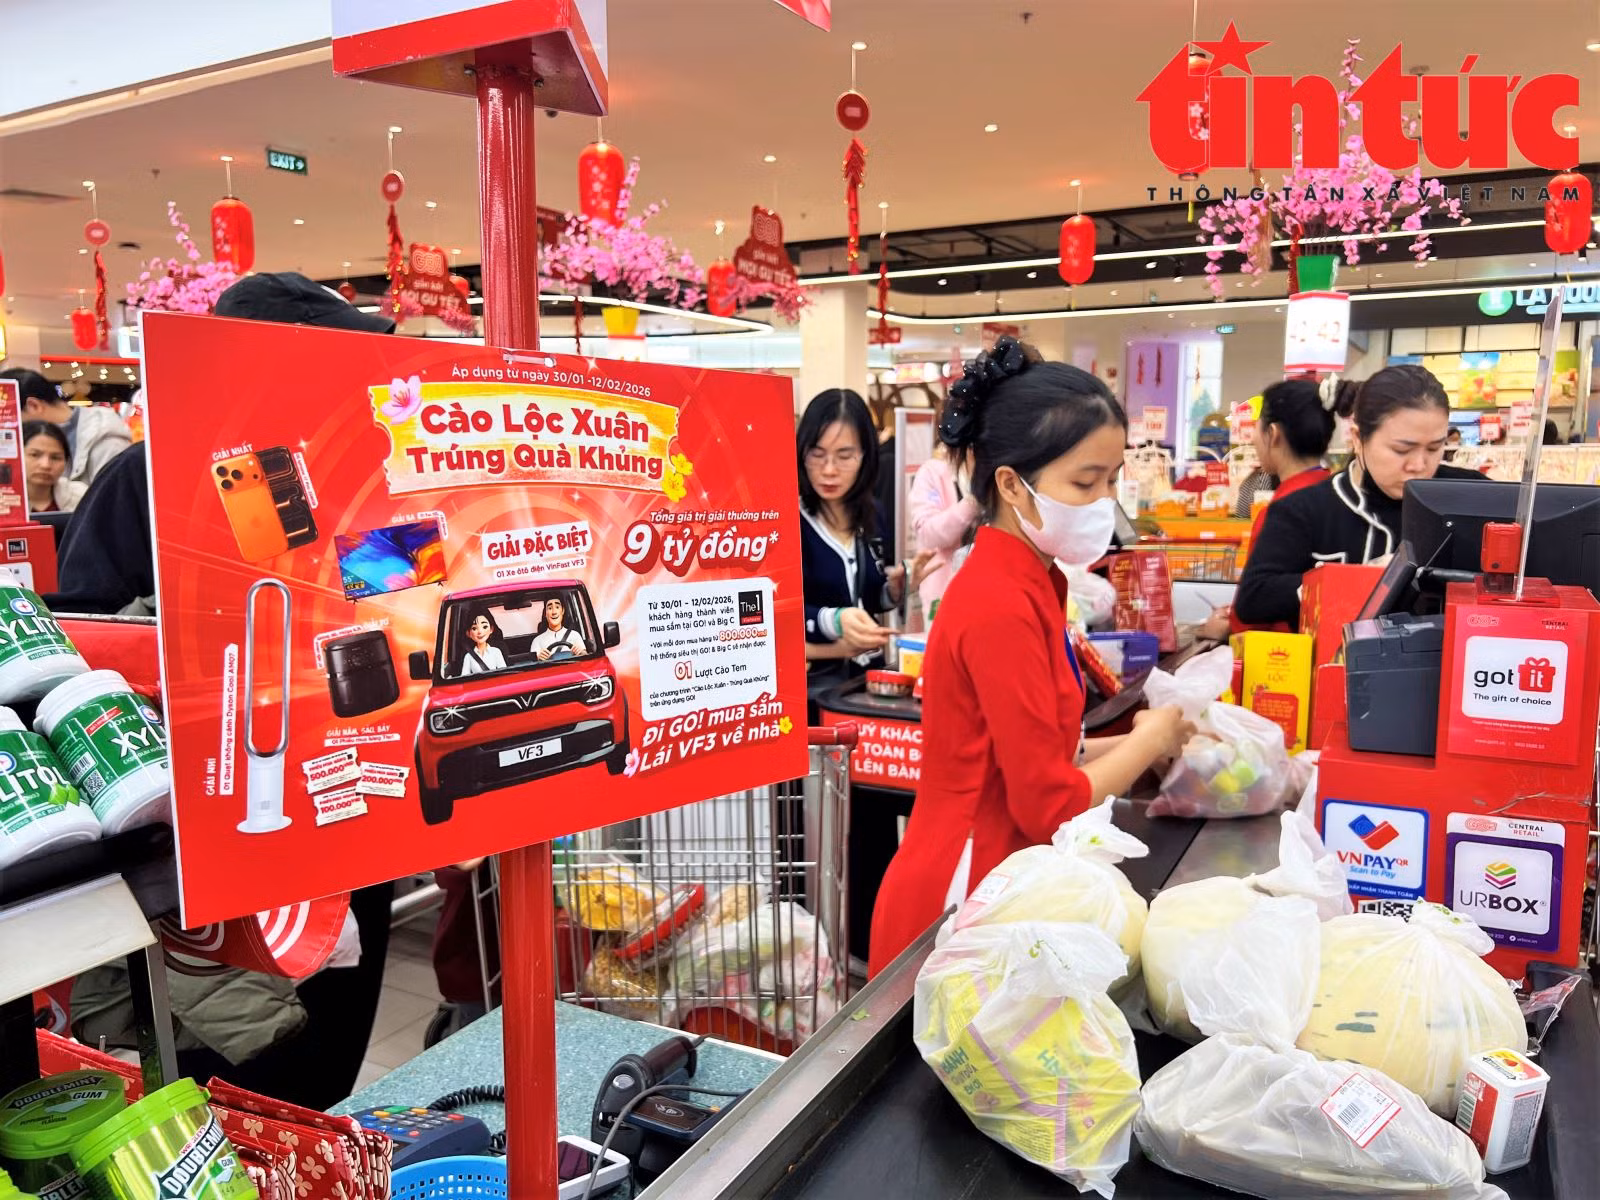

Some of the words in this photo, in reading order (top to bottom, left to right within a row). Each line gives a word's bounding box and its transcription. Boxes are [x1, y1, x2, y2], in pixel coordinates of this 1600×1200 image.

[270, 151, 296, 170] EXIT
[451, 364, 470, 380] Áp
[472, 366, 504, 383] dụng
[506, 368, 520, 380] từ
[522, 369, 550, 384] ngày
[552, 371, 584, 386] 30/01
[420, 402, 494, 435] Cào
[502, 403, 565, 440] Lộc
[571, 406, 650, 444] Xuân
[406, 442, 506, 474] Trúng
[512, 443, 572, 472] Quà
[578, 444, 663, 480] Khủng
[650, 509, 674, 524] Tổng
[677, 510, 694, 524] giá
[695, 512, 706, 524] trị
[708, 510, 725, 522] giải
[728, 510, 760, 522] thưởng
[761, 509, 780, 520] trên
[487, 534, 521, 560] GIẢI
[523, 530, 554, 558] ĐẶC
[556, 525, 588, 552] BIỆT
[623, 523, 653, 564] 9
[662, 527, 694, 567] tỷ
[496, 570, 505, 578] 01
[530, 565, 545, 574] điện
[546, 561, 570, 570] VinFast
[572, 558, 584, 566] VF3
[648, 602, 658, 610] Từ
[660, 600, 682, 610] 30/01
[648, 612, 670, 621] khách
[674, 610, 693, 619] hàng
[696, 608, 716, 616] thành
[666, 622, 681, 631] sắm
[682, 622, 692, 630] tại
[717, 618, 728, 627] Big
[730, 616, 735, 624] C
[650, 654, 658, 662] hệ
[659, 650, 676, 660] thống
[674, 660, 692, 680] 01
[695, 668, 713, 678] Lượt
[715, 666, 730, 675] Cào
[732, 664, 747, 672] Tem
[1474, 668, 1514, 688] got
[1530, 669, 1544, 688] it
[226, 694, 236, 716] Dyson
[1473, 692, 1490, 700] The
[1492, 694, 1508, 702] gift
[1522, 697, 1552, 706] choice
[108, 714, 138, 728] LOTTE
[642, 722, 666, 748] Đi
[669, 711, 706, 738] GO!
[708, 706, 745, 726] mua
[749, 693, 783, 718] sắm
[858, 722, 876, 737] UÝ
[518, 744, 544, 760] VF3
[640, 746, 673, 772] Lái
[678, 732, 716, 759] VF3
[722, 723, 744, 747] về
[748, 720, 781, 741] nhà
[862, 742, 906, 760] TOÀN
[854, 758, 884, 776] LÊN
[1508, 822, 1544, 832] CENTRAL
[1350, 866, 1368, 874] Scan
[1380, 870, 1396, 879] Pay
[15, 1077, 97, 1108] DOUBLEMINT
[72, 1092, 102, 1100] GUM
